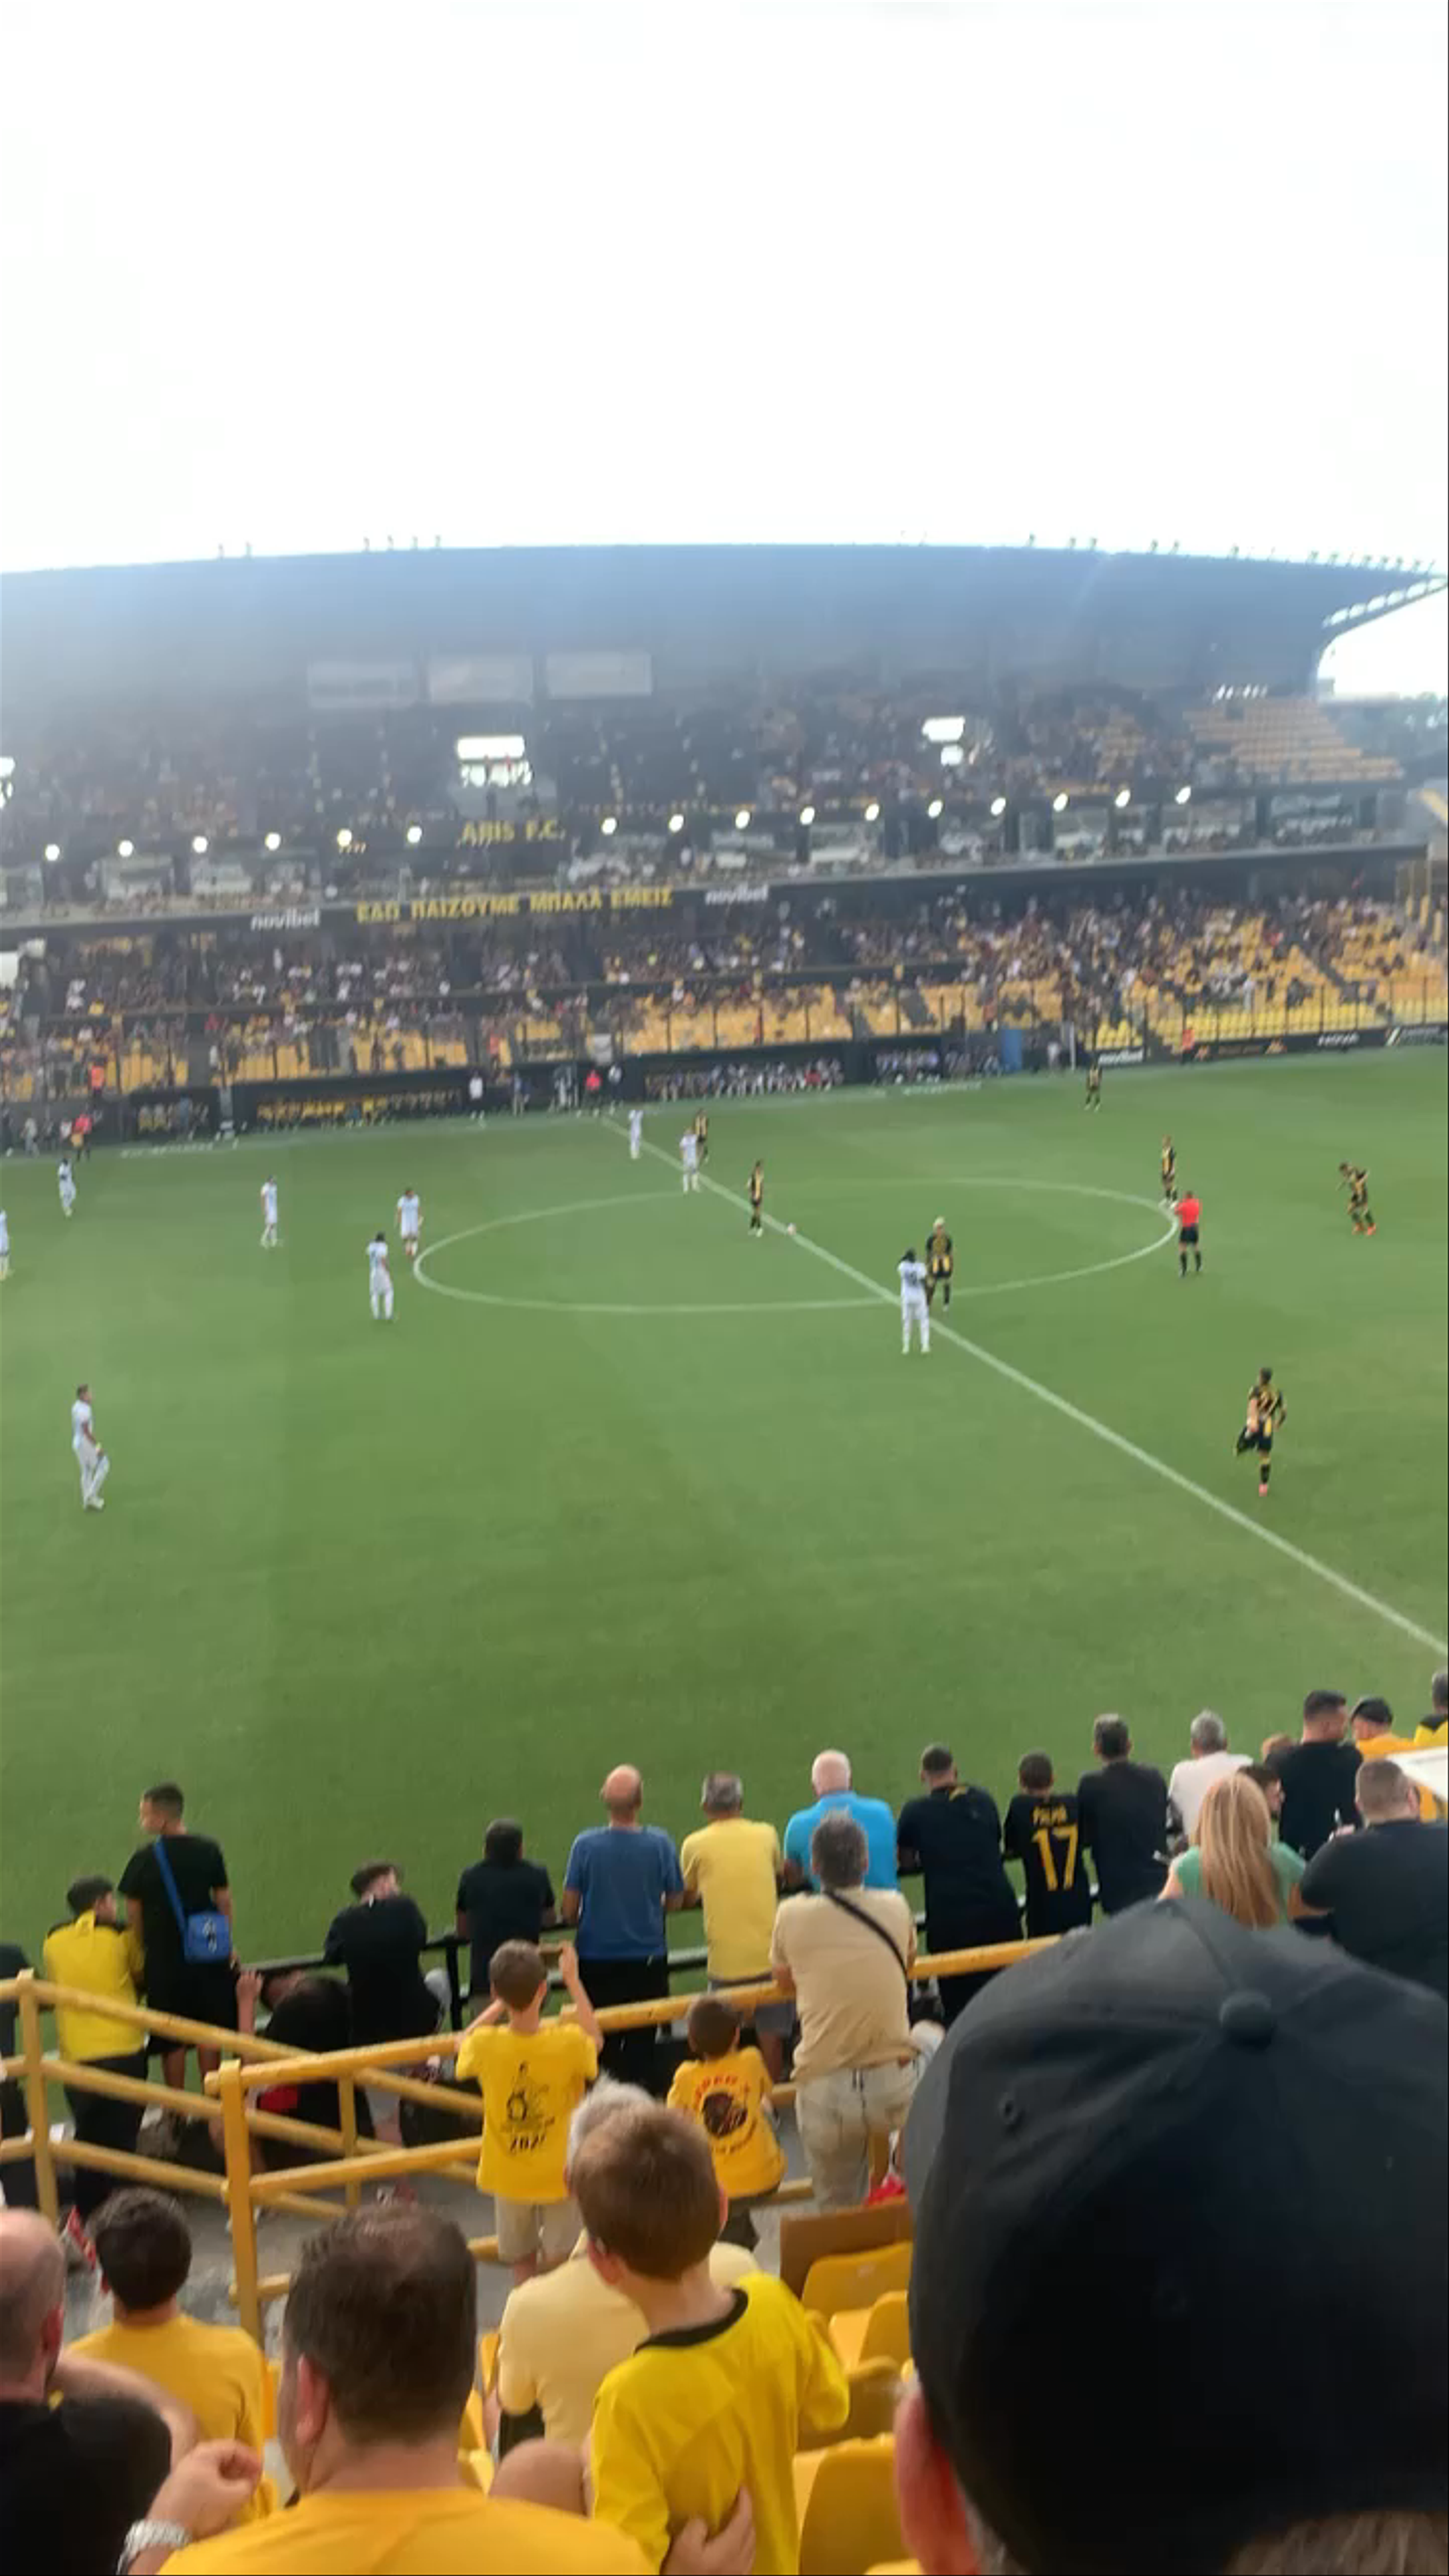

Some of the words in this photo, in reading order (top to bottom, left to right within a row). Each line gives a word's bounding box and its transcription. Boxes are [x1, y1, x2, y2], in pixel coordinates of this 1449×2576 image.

[705, 881, 769, 906] novibet
[251, 907, 320, 932] novibet
[1032, 1825, 1078, 1891] 17
